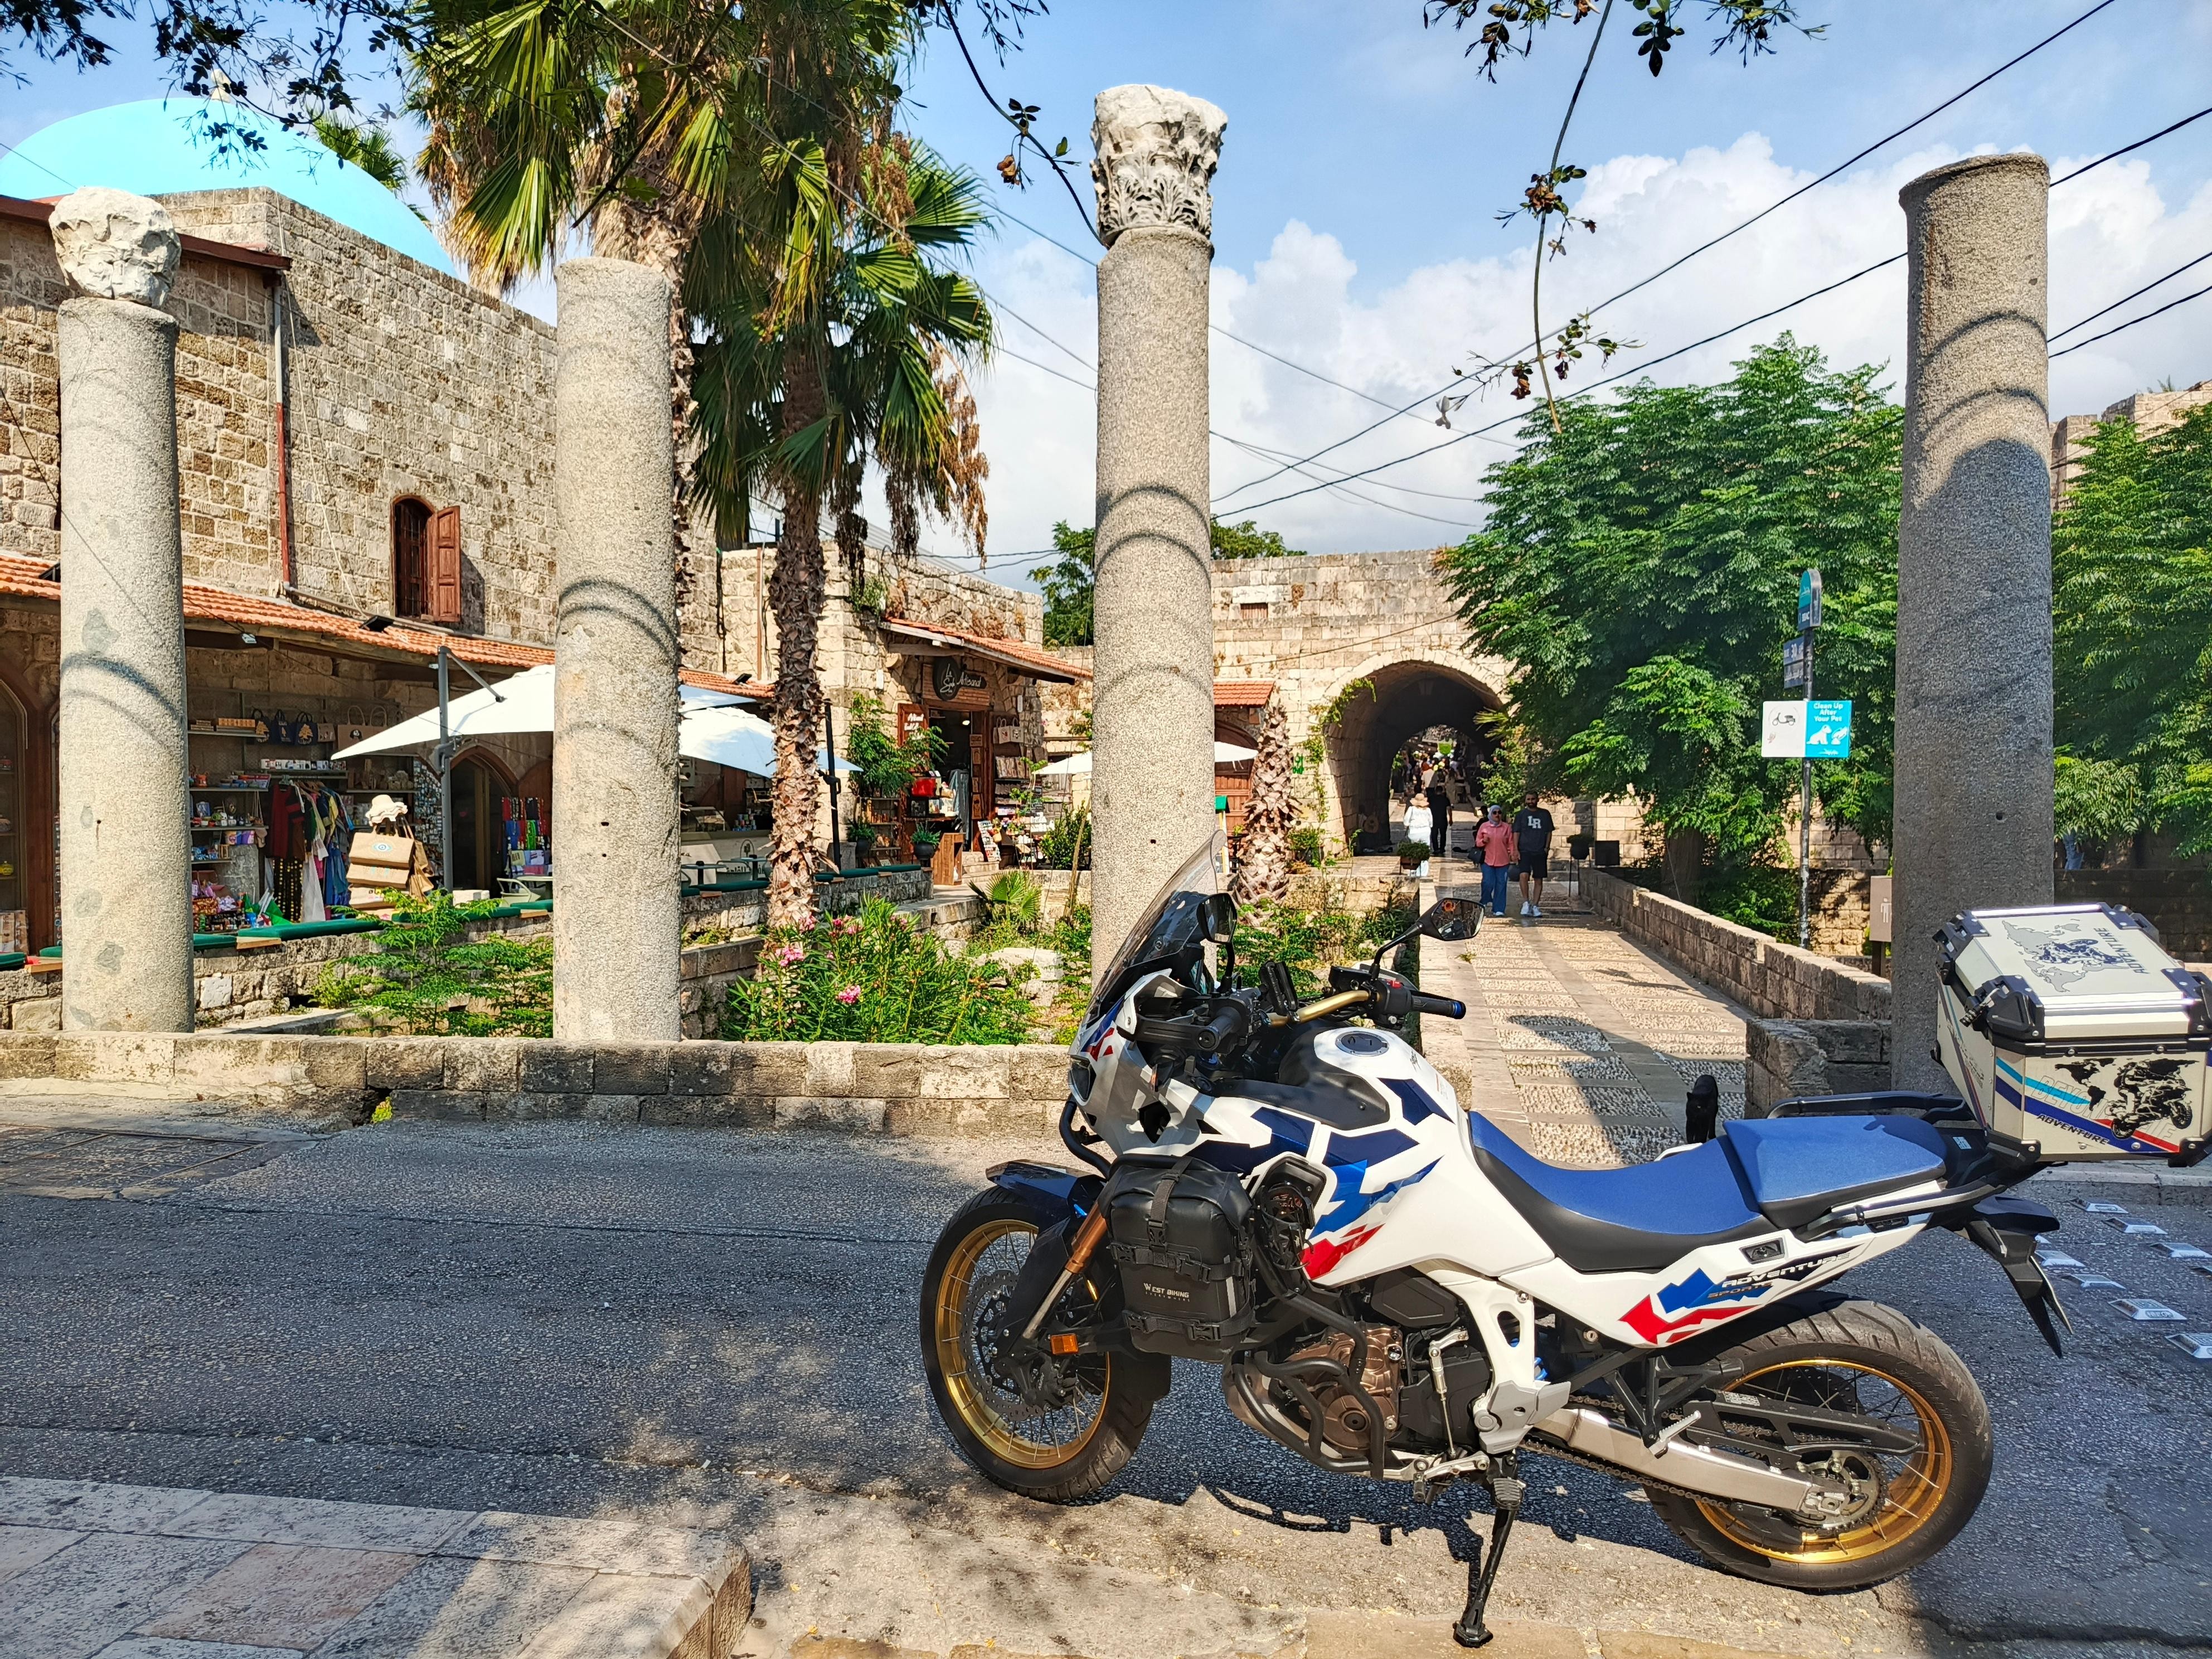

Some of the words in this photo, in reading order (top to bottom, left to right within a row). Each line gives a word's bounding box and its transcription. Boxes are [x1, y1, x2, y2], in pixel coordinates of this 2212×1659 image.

[2094, 928, 2150, 974] ADVENTURE
[2036, 1113, 2110, 1146] ADVENTURE
[1722, 1253, 1850, 1288] ADVENTURE
[1143, 1283, 1165, 1294] WEST
[1707, 1282, 1774, 1299] SPORTS
